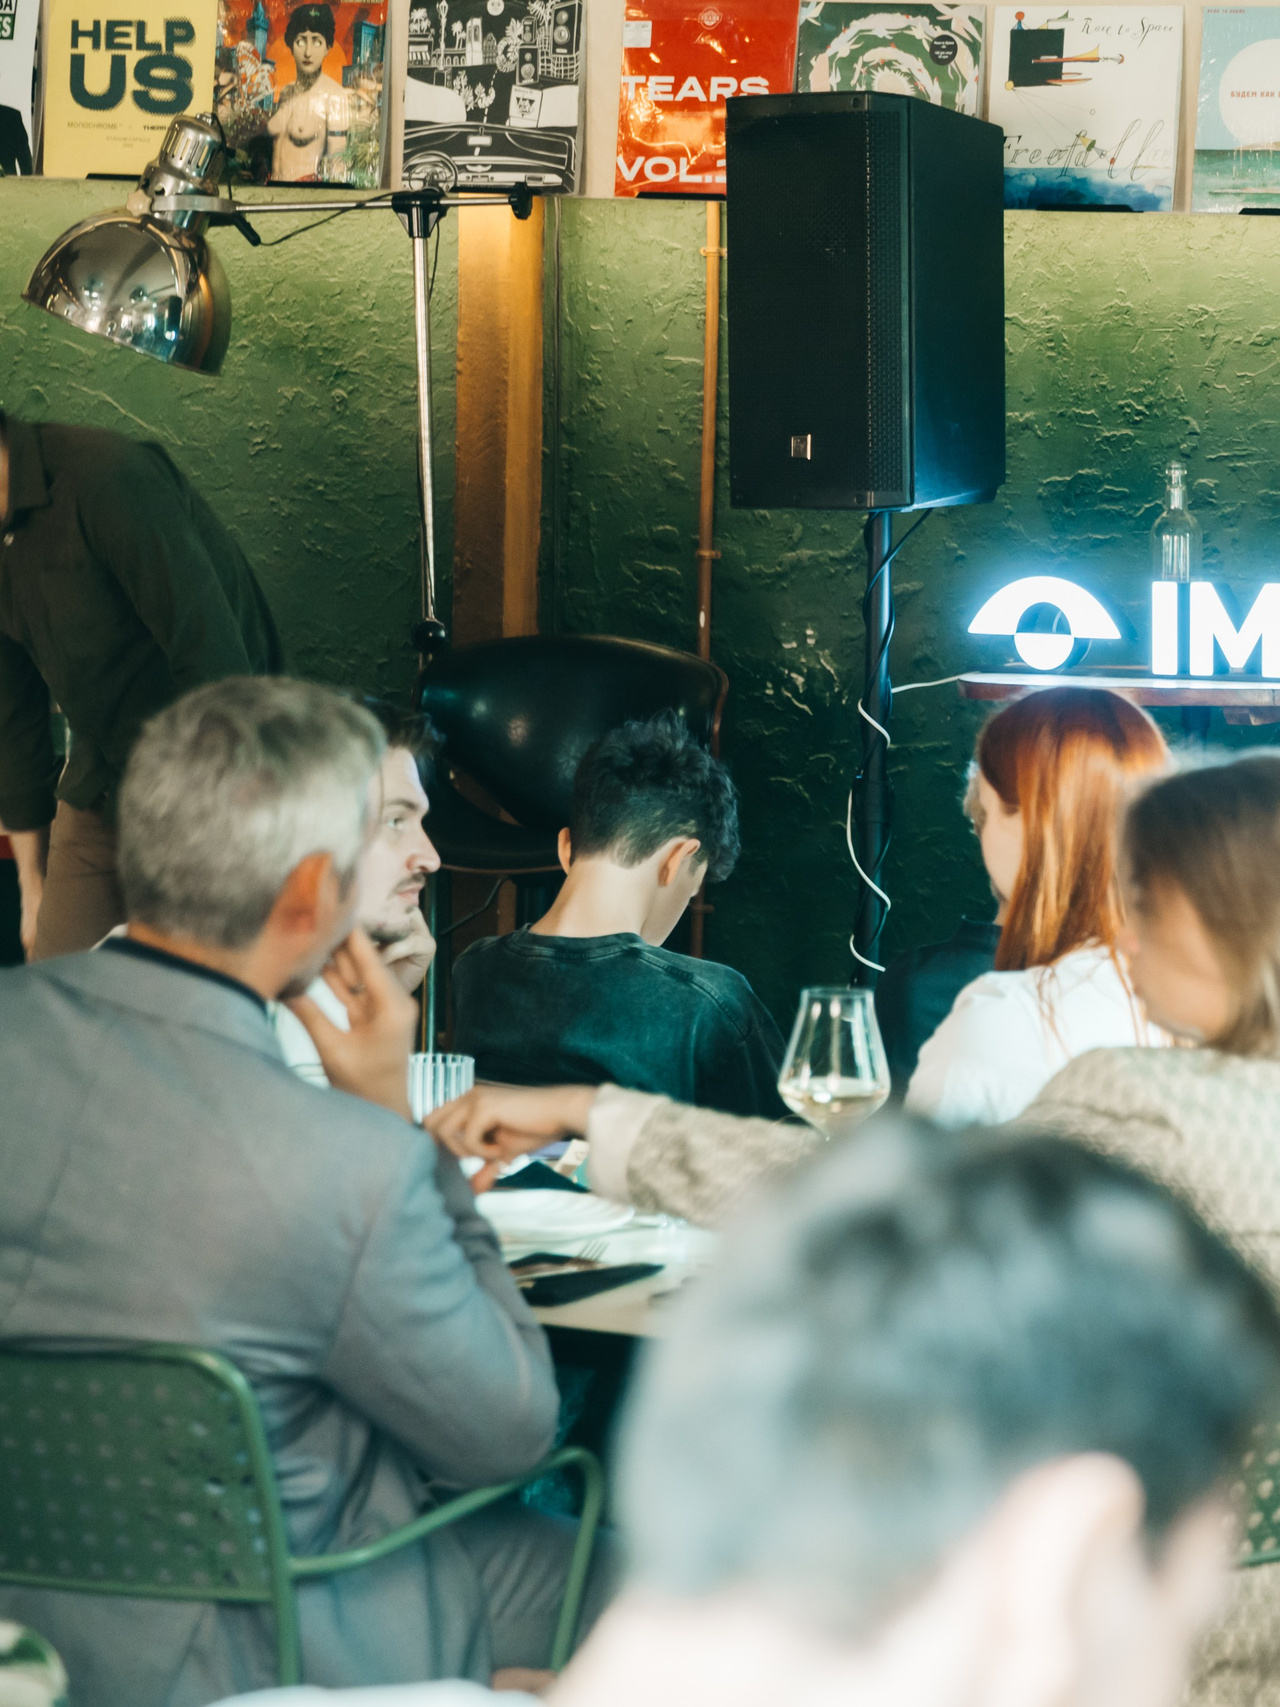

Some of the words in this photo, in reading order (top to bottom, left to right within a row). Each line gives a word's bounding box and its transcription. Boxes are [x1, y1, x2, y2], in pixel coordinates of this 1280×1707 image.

[70, 17, 196, 55] HELP
[1081, 17, 1112, 35] Race
[1117, 24, 1130, 35] to
[1131, 16, 1174, 50] Space
[69, 53, 194, 117] US
[621, 75, 770, 102] TEARS
[1230, 91, 1257, 99] БУДЕМ
